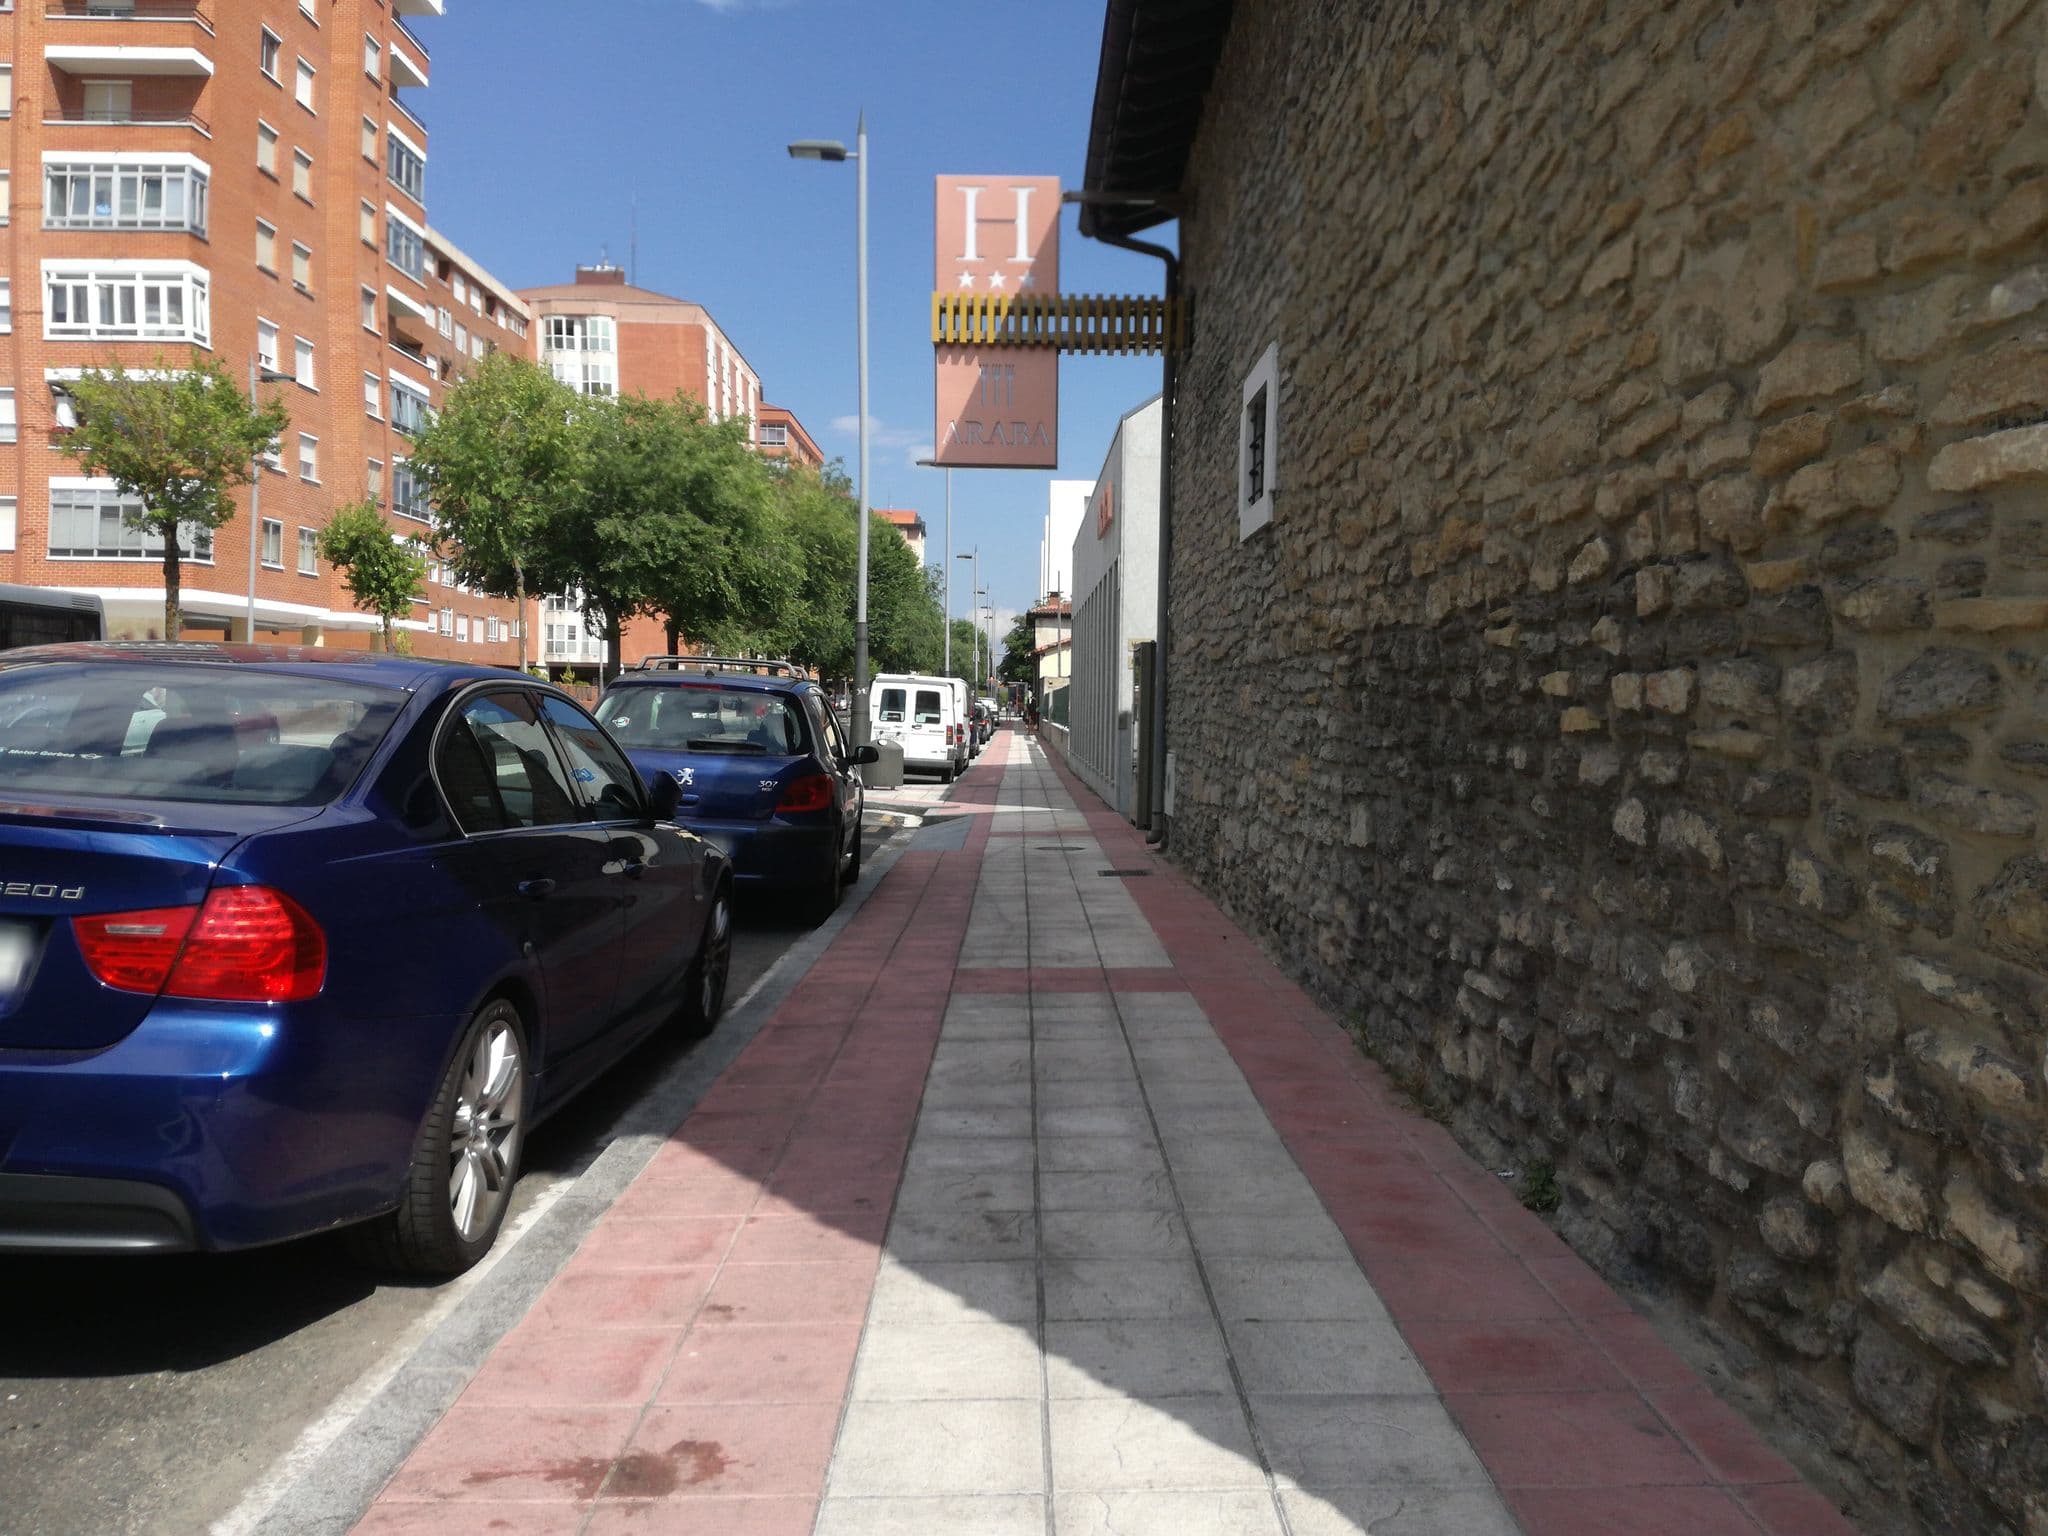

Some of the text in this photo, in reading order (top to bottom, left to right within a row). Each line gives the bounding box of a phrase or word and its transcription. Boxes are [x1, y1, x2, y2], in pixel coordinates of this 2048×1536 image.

[955, 185, 1037, 262] H
[942, 419, 1050, 448] ARABA
[758, 780, 779, 788] 307
[0, 881, 85, 899] 20d
